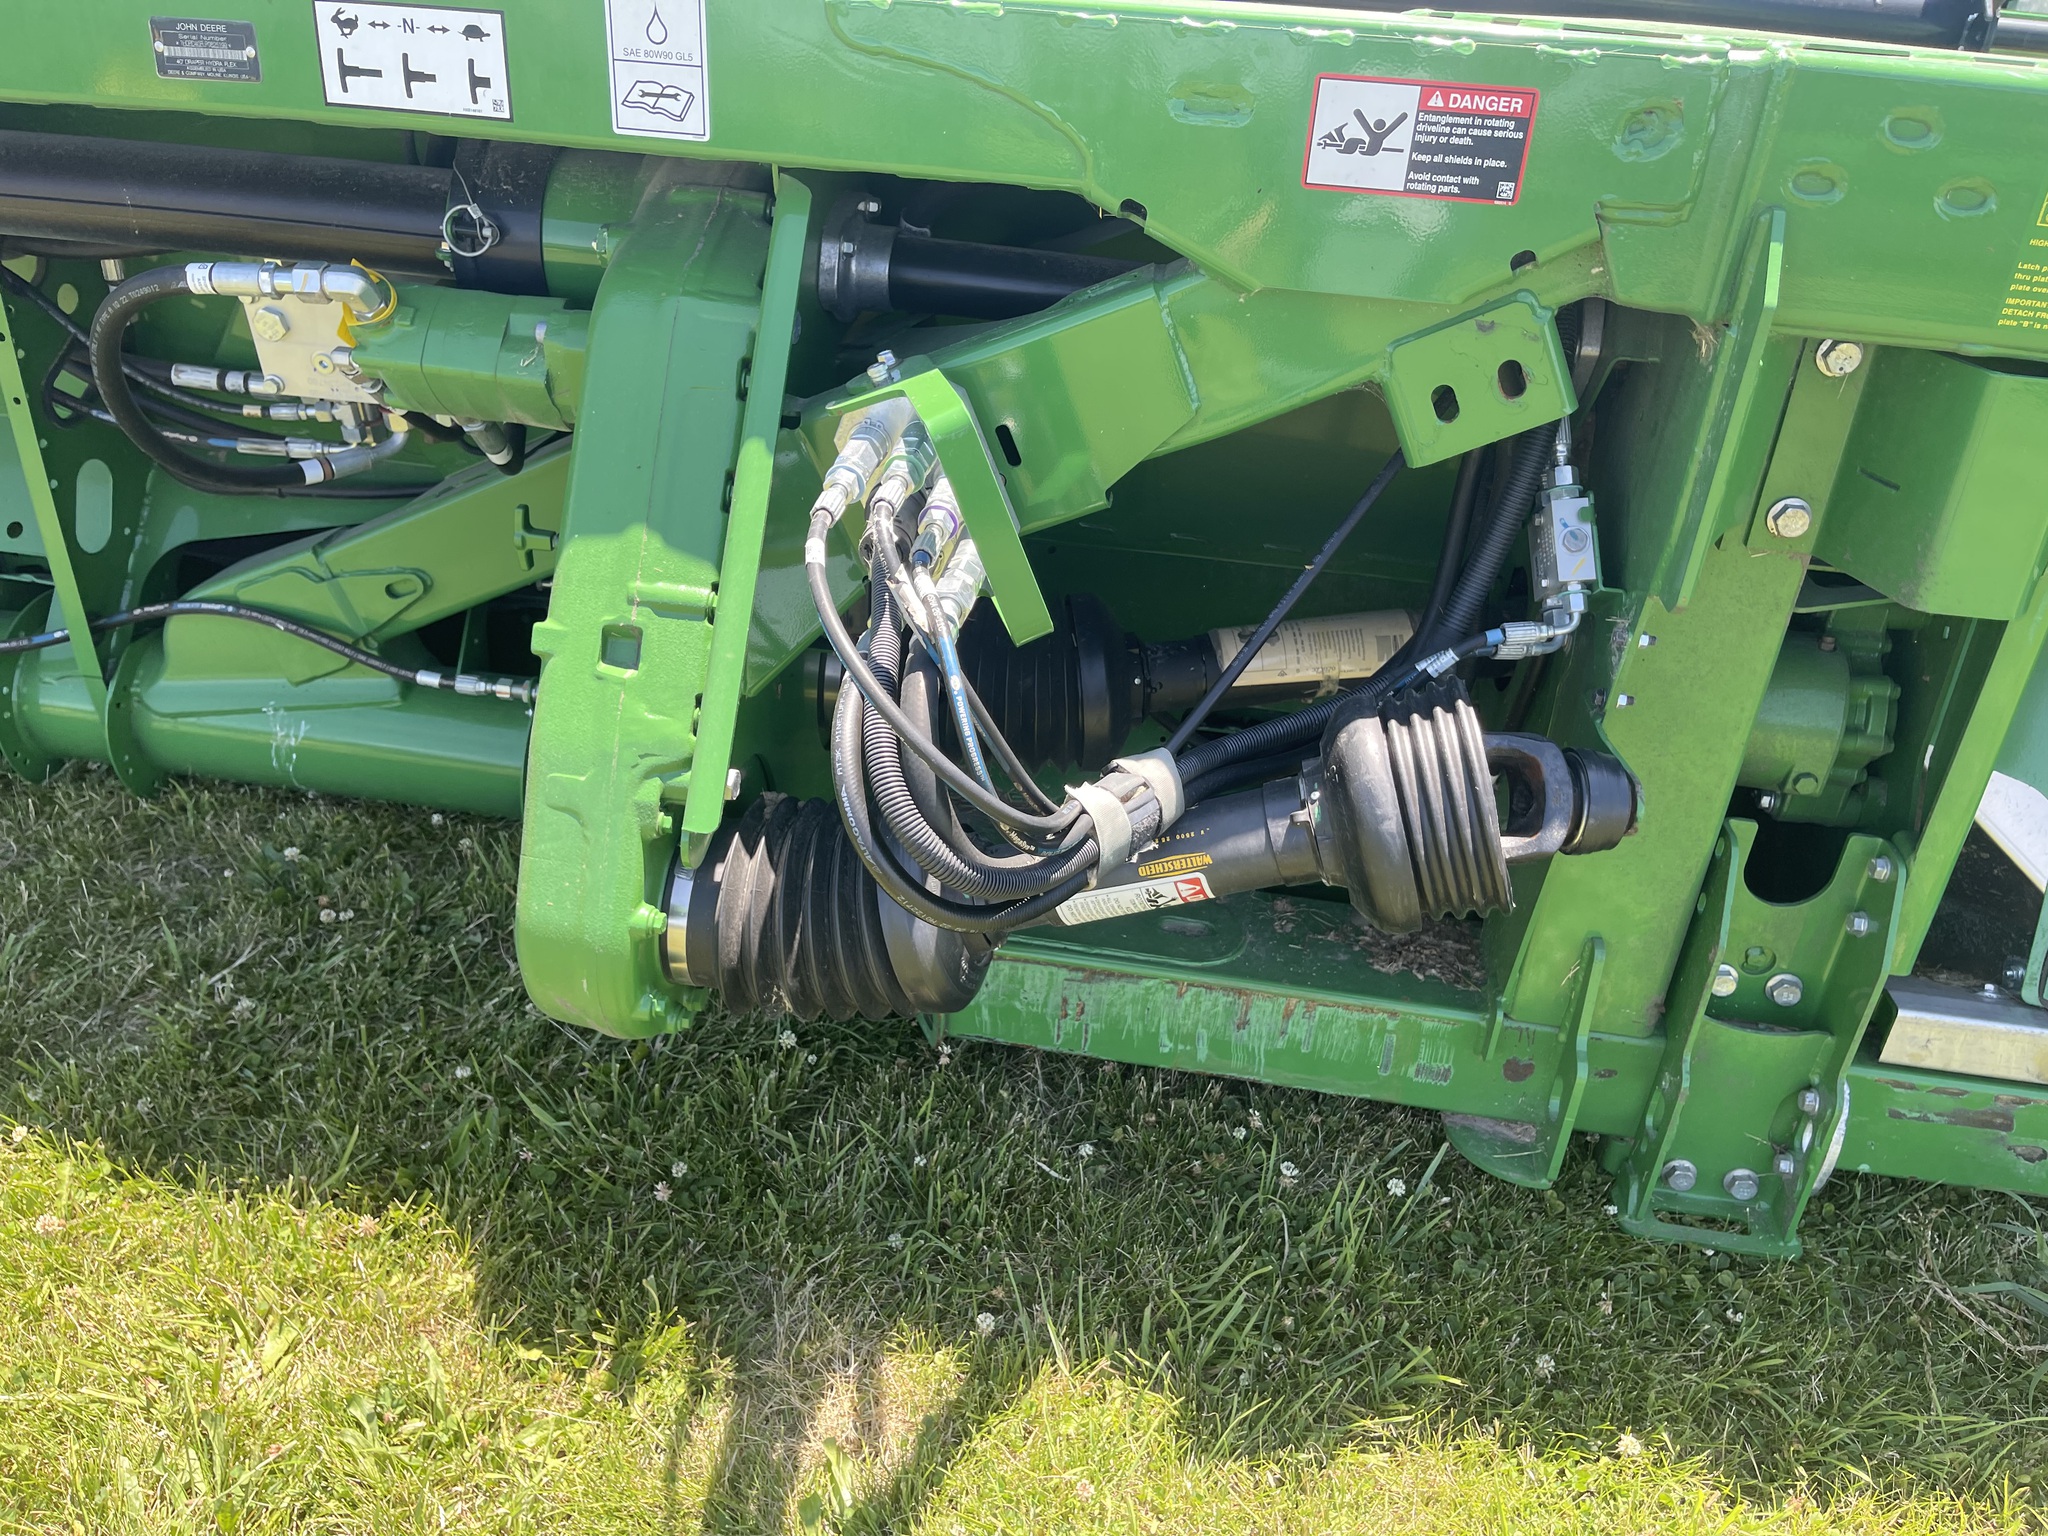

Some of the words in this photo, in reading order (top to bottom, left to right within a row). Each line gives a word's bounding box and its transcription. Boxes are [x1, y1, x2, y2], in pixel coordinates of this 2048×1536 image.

[176, 22, 197, 31] JOHN
[200, 24, 227, 32] DEERE
[622, 47, 642, 58] SAE
[644, 48, 674, 60] 80W90
[676, 51, 694, 62] GL5
[1448, 94, 1523, 112] DANGER
[1418, 112, 1473, 125] Entanglement
[1474, 116, 1482, 125] in
[1484, 117, 1515, 129] rotating
[1416, 123, 1450, 133] driveline
[1452, 126, 1466, 134] can
[1468, 128, 1492, 136] cause
[1494, 129, 1523, 139] serious
[1415, 133, 1436, 144] injury
[1450, 136, 1474, 146] death.
[1411, 152, 1432, 163] Keep
[1444, 155, 1472, 165] shields
[1474, 157, 1482, 165] in
[1483, 158, 1507, 168] place.
[1408, 171, 1430, 180] Avoid
[1432, 174, 1461, 183] contact
[1463, 176, 1480, 185] with
[1406, 182, 1439, 193] rotating
[1438, 185, 1460, 194] parts.
[2018, 262, 2040, 271] Latch
[2014, 273, 2031, 281] thru
[2002, 308, 2034, 317] DETACH
[955, 696, 971, 736] POWERING
[840, 784, 876, 866] ALFAGOMMA
[1138, 854, 1212, 877] WALTERSCHEID
